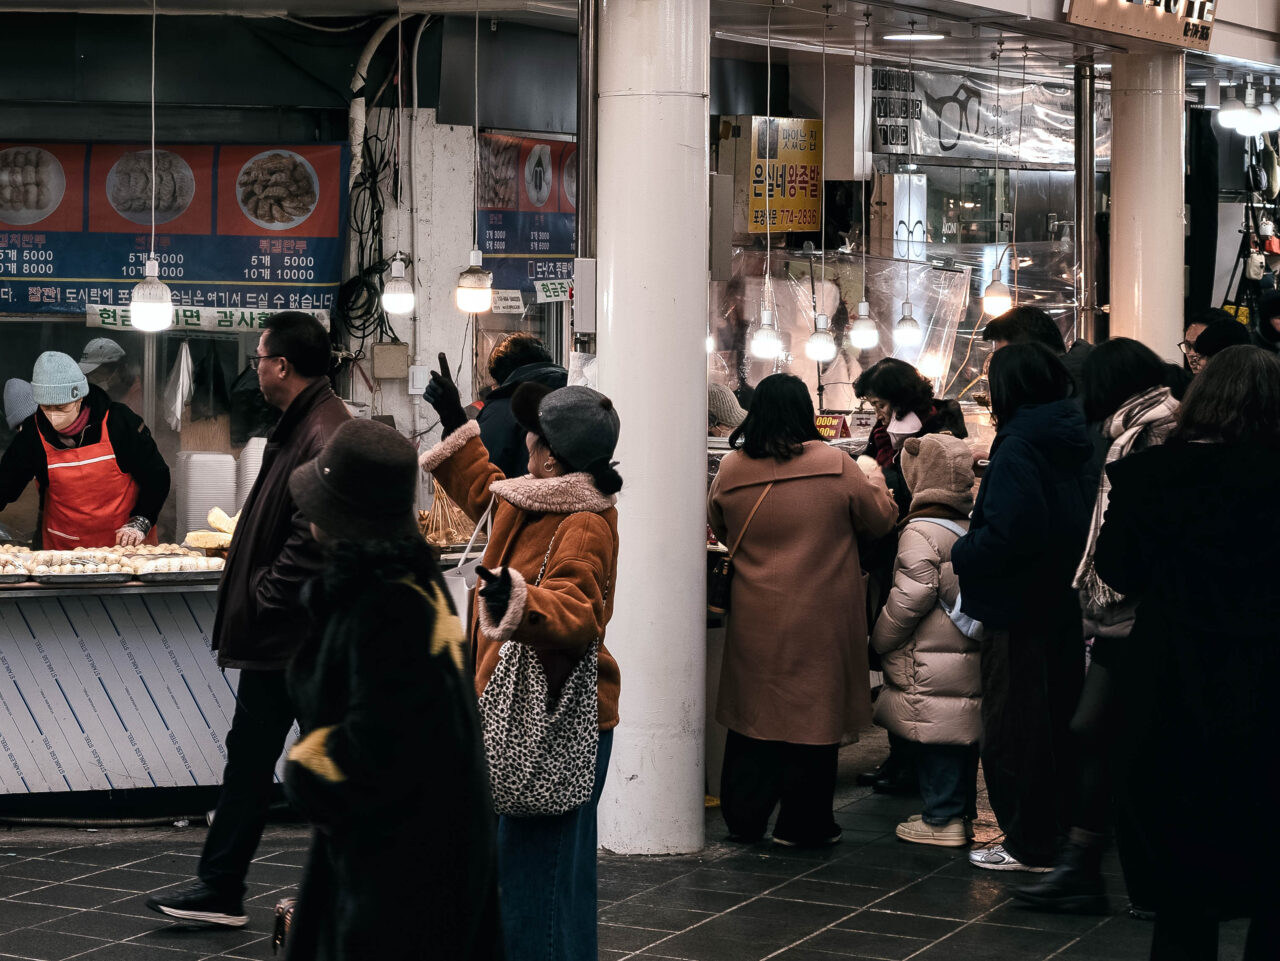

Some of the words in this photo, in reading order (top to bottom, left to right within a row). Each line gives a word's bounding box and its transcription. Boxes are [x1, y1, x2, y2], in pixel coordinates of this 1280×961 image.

[782, 128, 806, 151] 맛있는
[809, 130, 817, 151] 집
[780, 209, 817, 225] 774-2836
[259, 239, 307, 254] 튀김만두
[22, 250, 54, 261] 5000
[129, 253, 148, 264] 5개
[251, 255, 271, 267] 5개
[284, 257, 314, 267] 5000
[22, 263, 54, 274] 8000
[155, 266, 184, 277] 000
[244, 268, 271, 280] 10개
[276, 269, 314, 280] 10000
[536, 262, 555, 278] 도넛츠
[66, 288, 113, 304] 도시락에
[207, 292, 241, 308] 여기서
[246, 293, 269, 309] 드실
[273, 294, 285, 309] 수
[99, 308, 201, 327] 현금면
